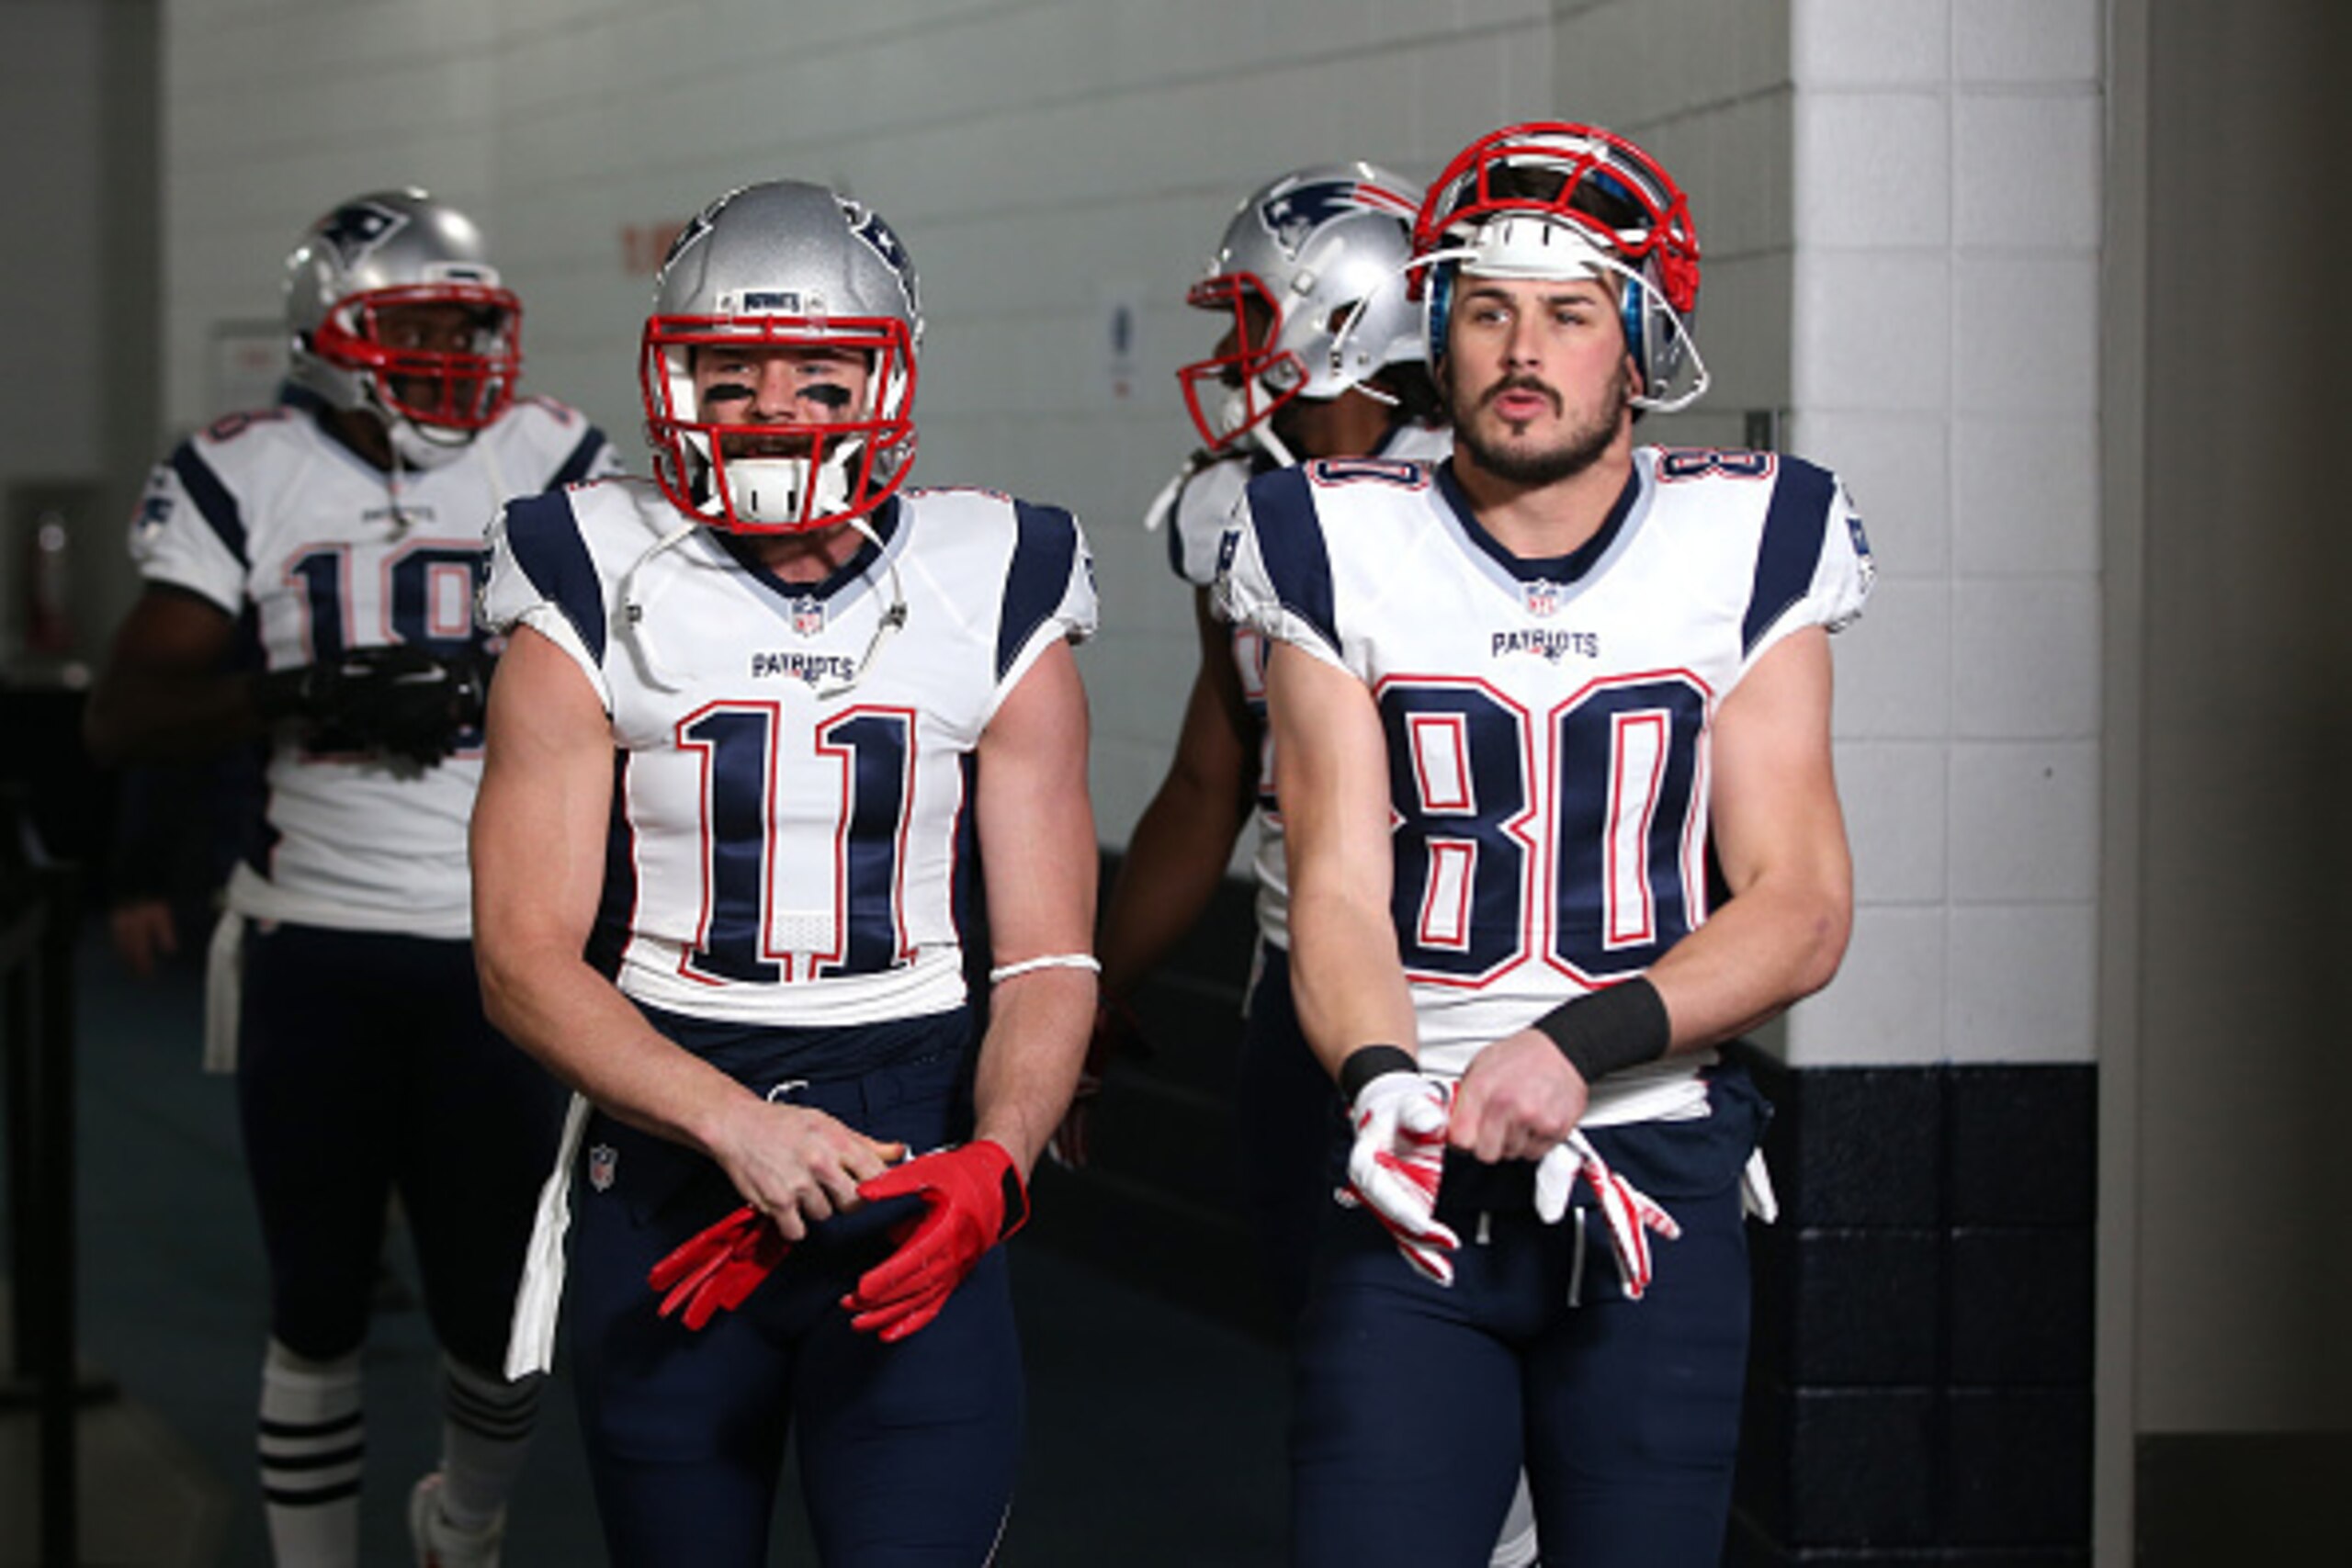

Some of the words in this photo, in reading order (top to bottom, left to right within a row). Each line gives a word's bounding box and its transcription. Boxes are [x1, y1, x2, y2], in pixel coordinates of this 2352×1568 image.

[752, 652, 855, 682] PATRIOTS
[1491, 628, 1598, 659] PATRIOTS
[674, 699, 917, 983] 11
[1374, 667, 1715, 991] 80
